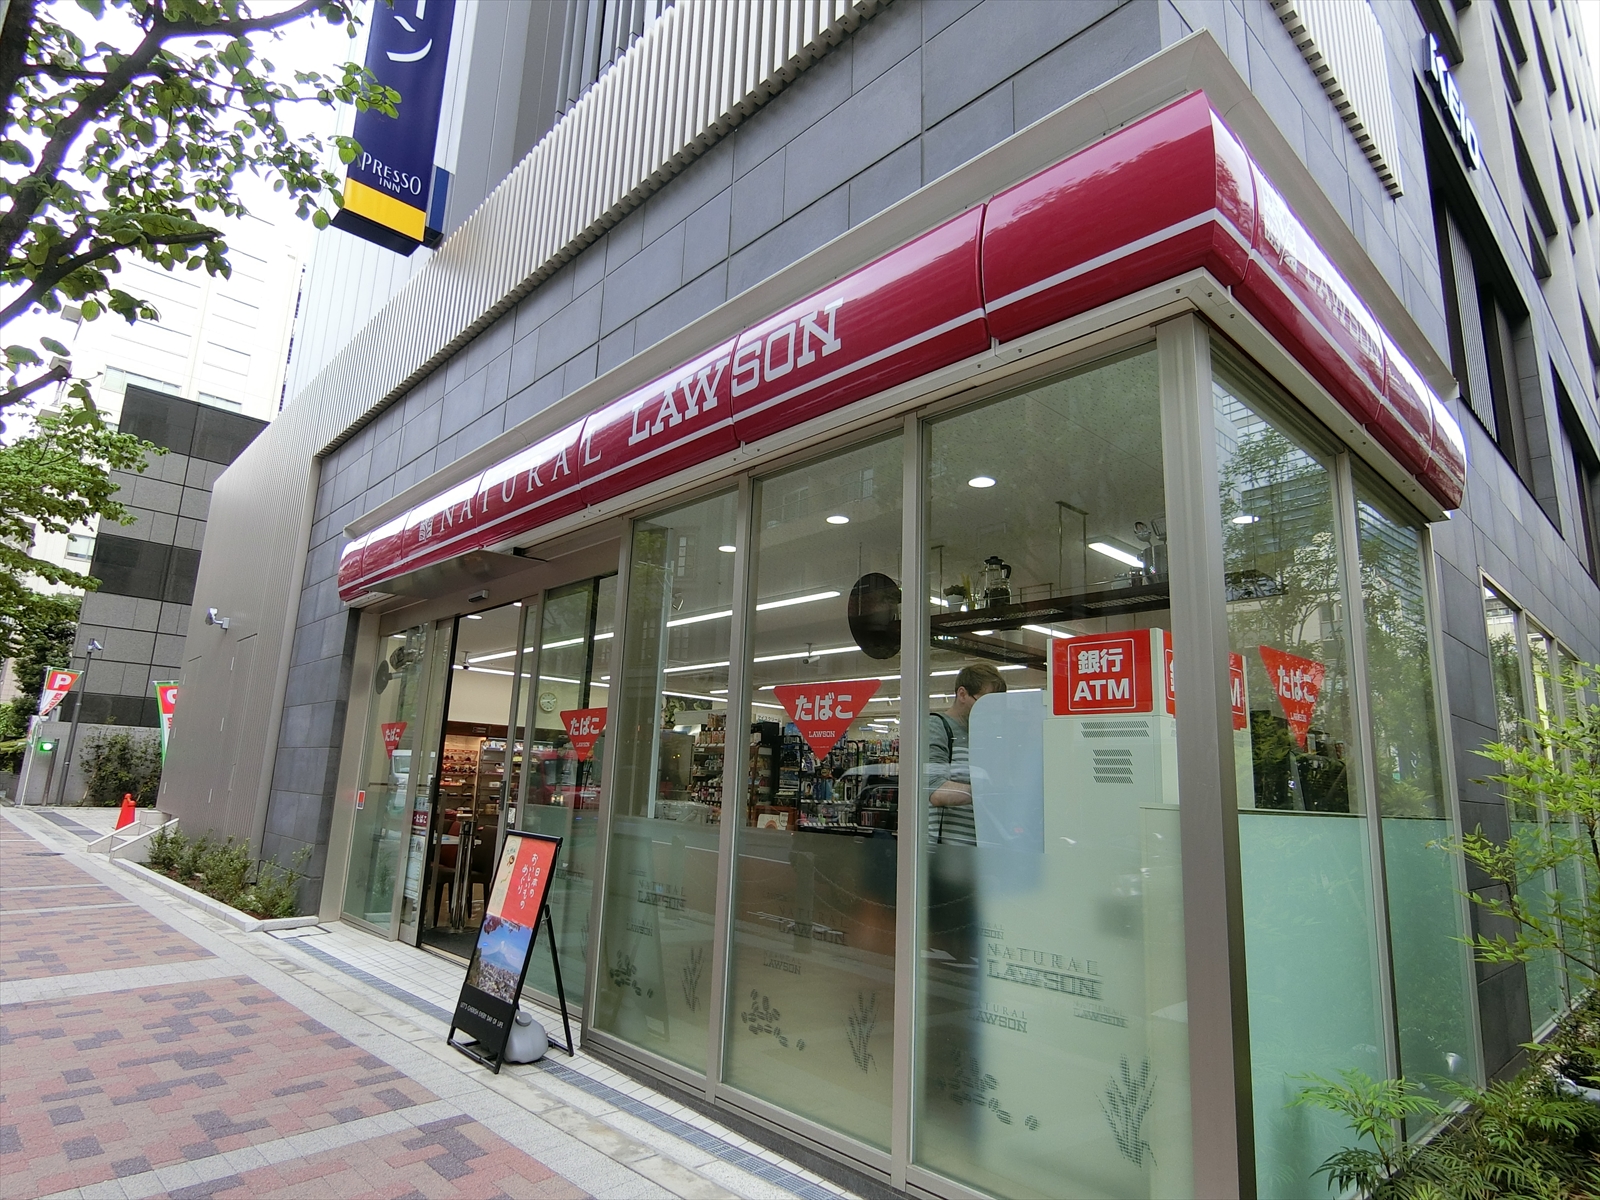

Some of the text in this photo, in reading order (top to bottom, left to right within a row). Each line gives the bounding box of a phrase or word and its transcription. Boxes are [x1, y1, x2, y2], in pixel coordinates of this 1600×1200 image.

[361, 151, 422, 195] PRESSO
[379, 177, 401, 194] INN
[439, 296, 844, 533] NATURAL LAWSON
[1077, 647, 1124, 675] 銀行
[53, 673, 72, 689] P
[1073, 677, 1130, 702] ATM
[794, 691, 853, 721] たばこ
[569, 715, 600, 736] たばこ
[808, 730, 836, 738] LAWSON
[763, 958, 802, 976] LAWSON
[986, 943, 1103, 978] NATURAL
[986, 957, 1105, 1001] LAWSON
